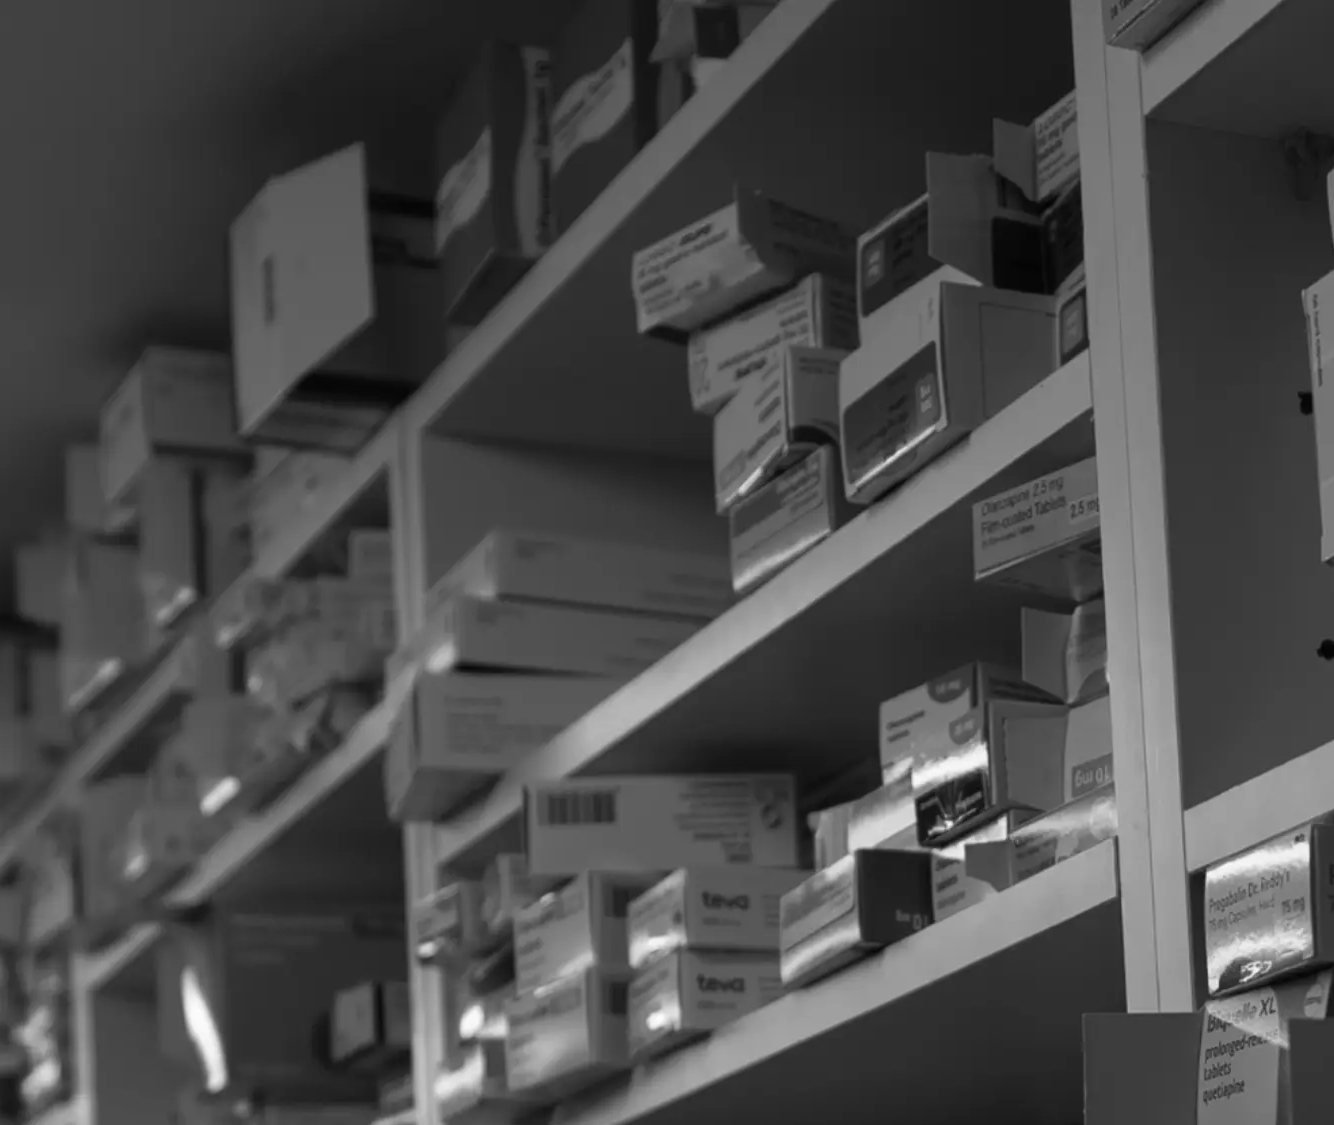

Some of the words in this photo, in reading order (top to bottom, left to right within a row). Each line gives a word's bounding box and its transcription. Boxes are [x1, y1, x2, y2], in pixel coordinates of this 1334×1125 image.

[981, 490, 1029, 516] Olanzapine
[1033, 480, 1047, 498] 2.5
[1049, 476, 1065, 492] mg
[1034, 495, 1066, 516] Tablets
[1070, 501, 1084, 519] 2.5
[701, 890, 750, 911] teva
[1209, 888, 1247, 914] Pregabalin
[1260, 868, 1290, 890] Reddy's
[1281, 900, 1292, 915] 75
[1292, 897, 1305, 913] mg
[696, 973, 745, 994] teva
[1259, 996, 1277, 1018] XL
[1205, 1030, 1279, 1063] prolonged-rele
[1204, 1061, 1231, 1081] tablets
[1203, 1079, 1245, 1107] quetiapine
